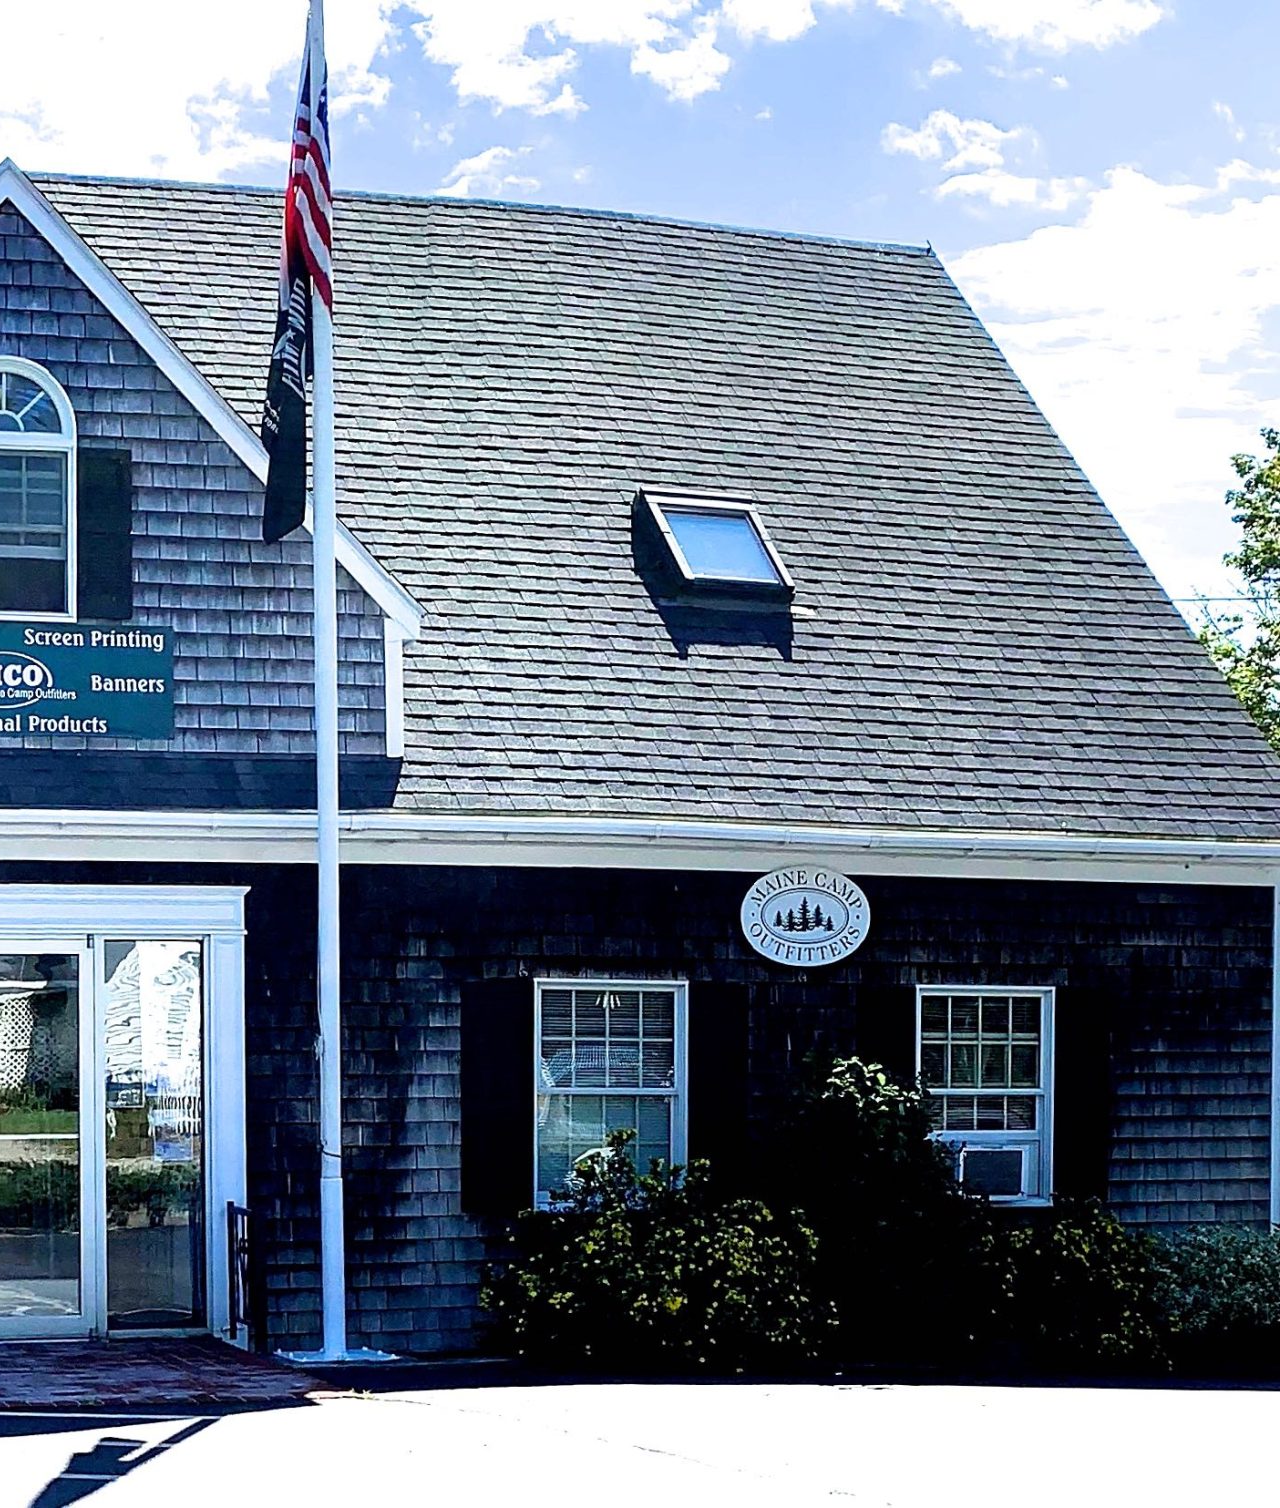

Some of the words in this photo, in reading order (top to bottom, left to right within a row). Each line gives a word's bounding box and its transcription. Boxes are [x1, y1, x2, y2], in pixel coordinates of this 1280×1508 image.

[24, 628, 84, 647] Screen
[91, 630, 165, 653] Printing
[7, 688, 34, 700] Camp
[35, 688, 77, 700] Outfitters
[91, 675, 165, 693] Banners
[28, 715, 107, 734] Products
[750, 870, 808, 908] MAINE
[815, 872, 863, 909] CAMP
[750, 923, 861, 962] OUTFITTERS
